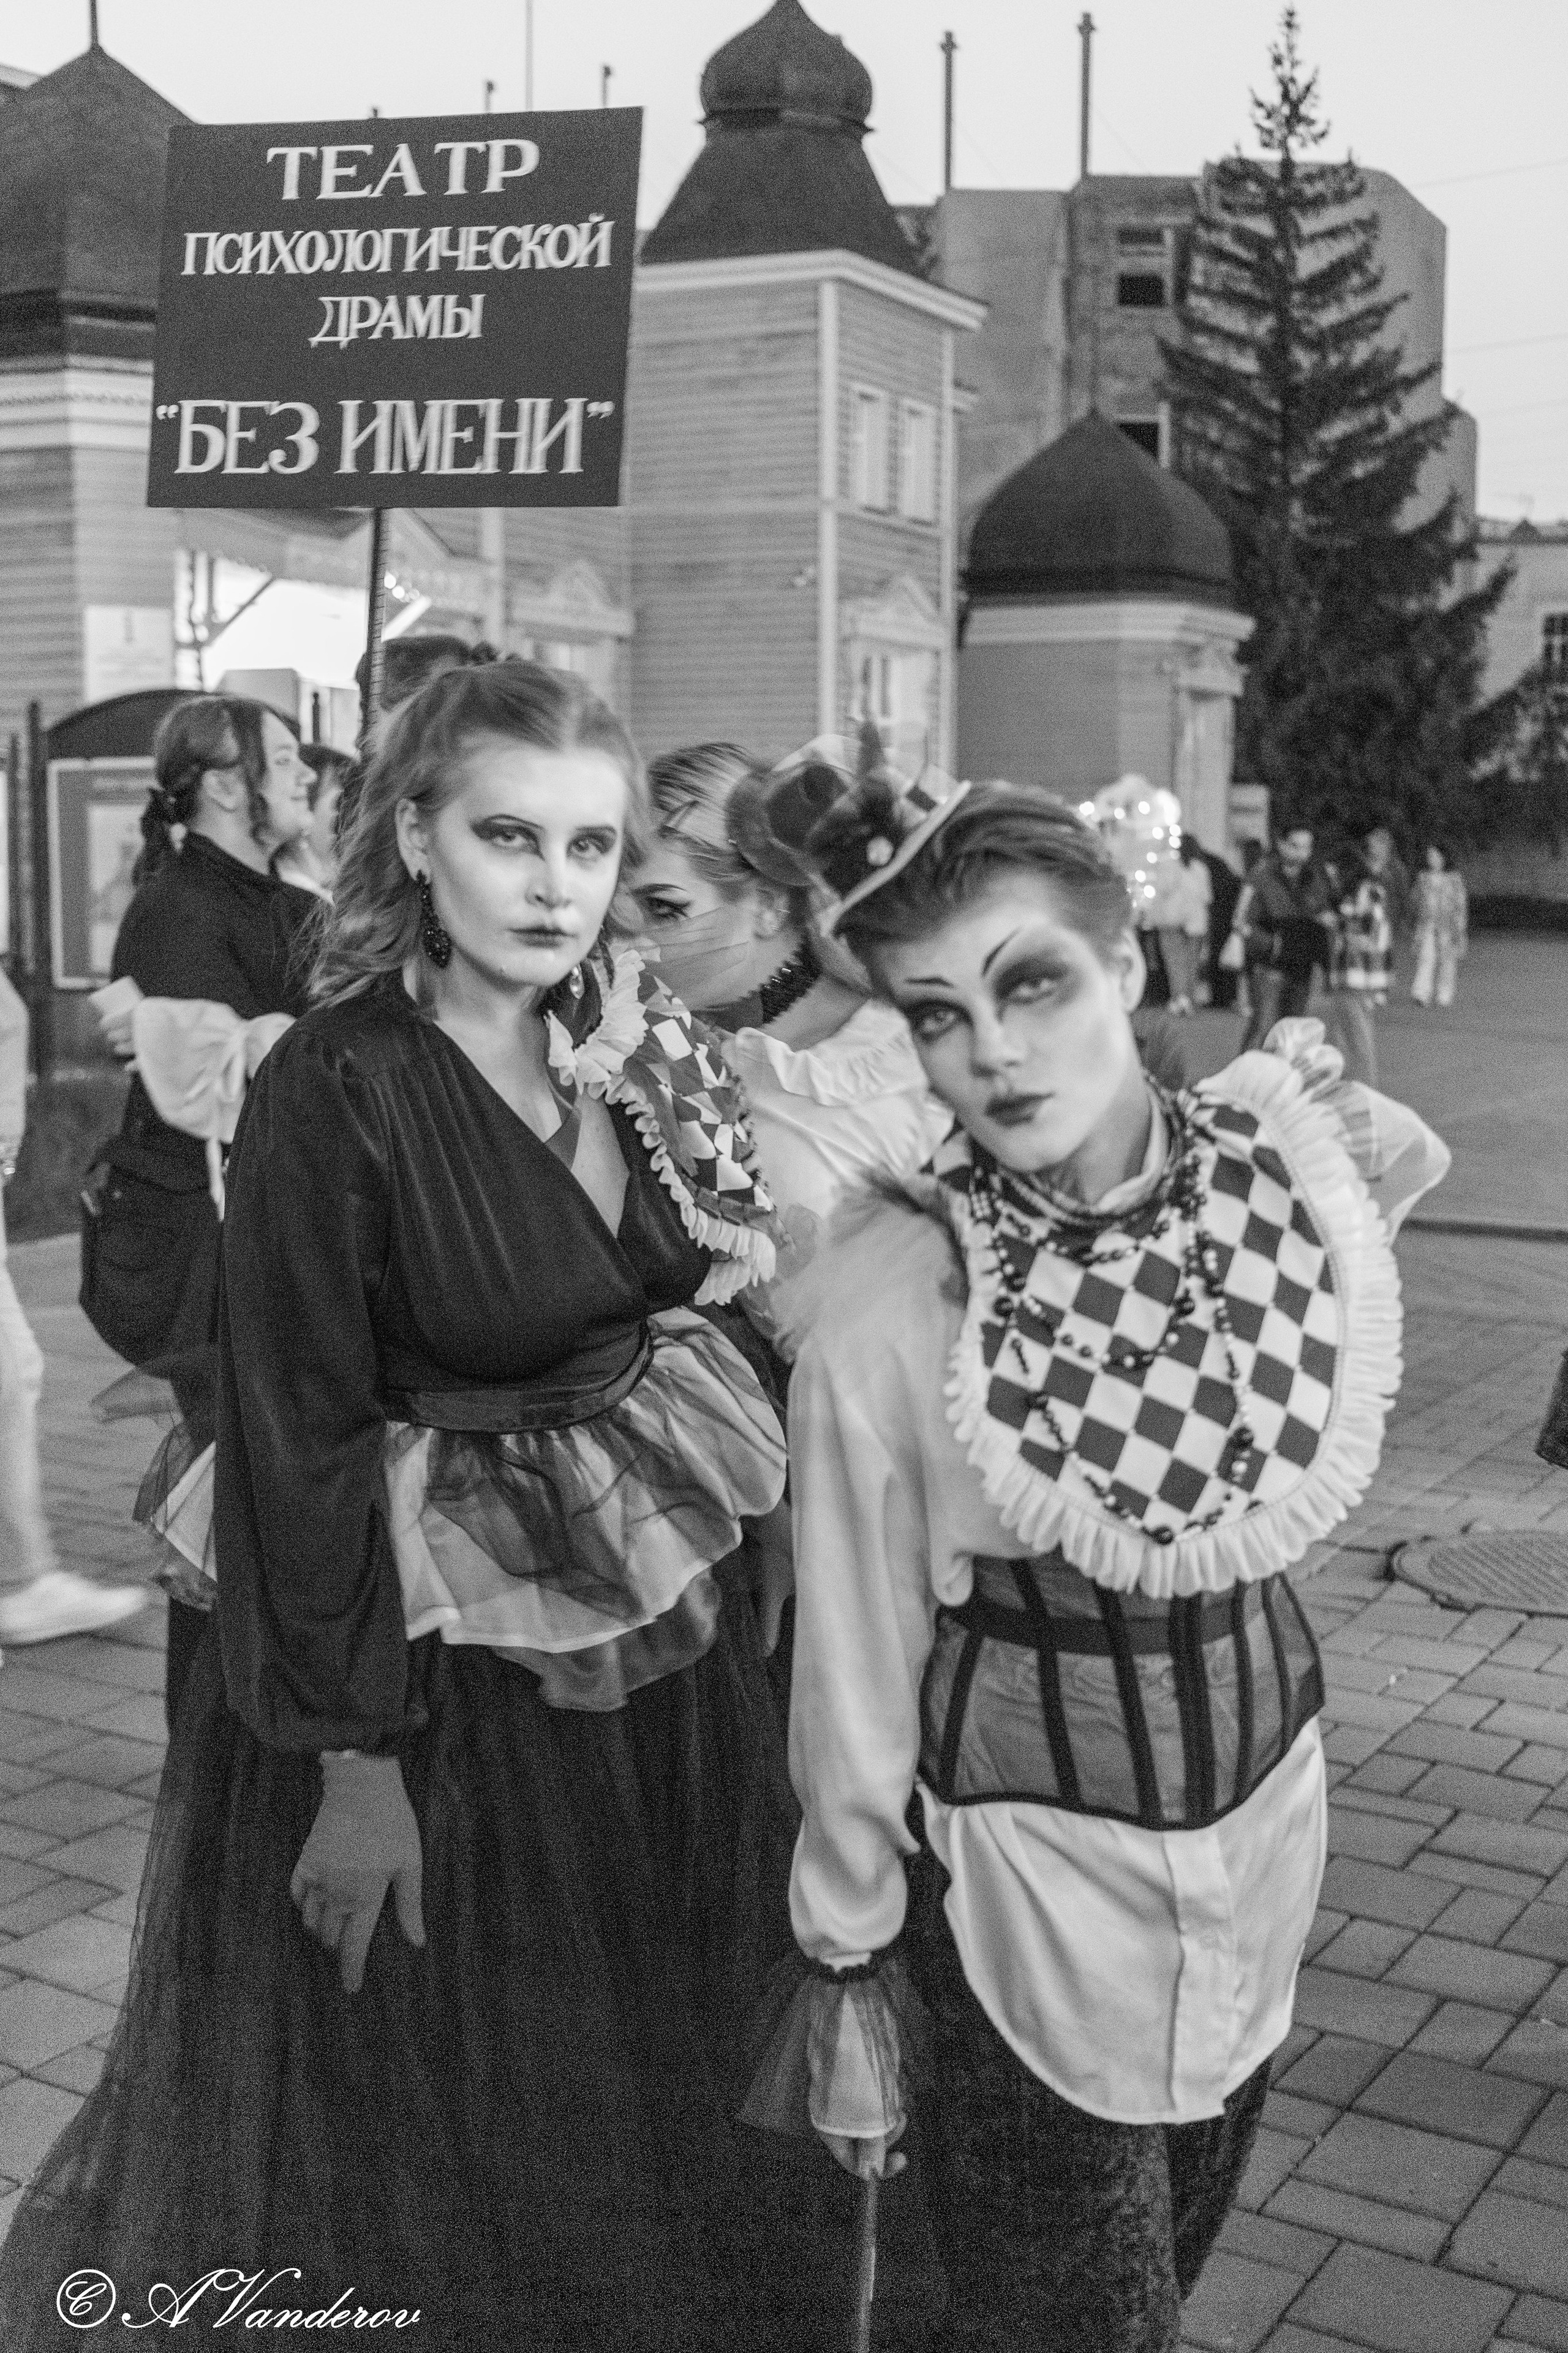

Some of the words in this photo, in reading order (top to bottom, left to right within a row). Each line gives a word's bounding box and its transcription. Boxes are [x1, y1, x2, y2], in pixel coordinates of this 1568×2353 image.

[267, 138, 540, 200] ТЕАТР
[181, 213, 615, 275] ПСИХОЛОГИЧЕСКОЙ
[309, 294, 486, 348] ДРАМЫ
